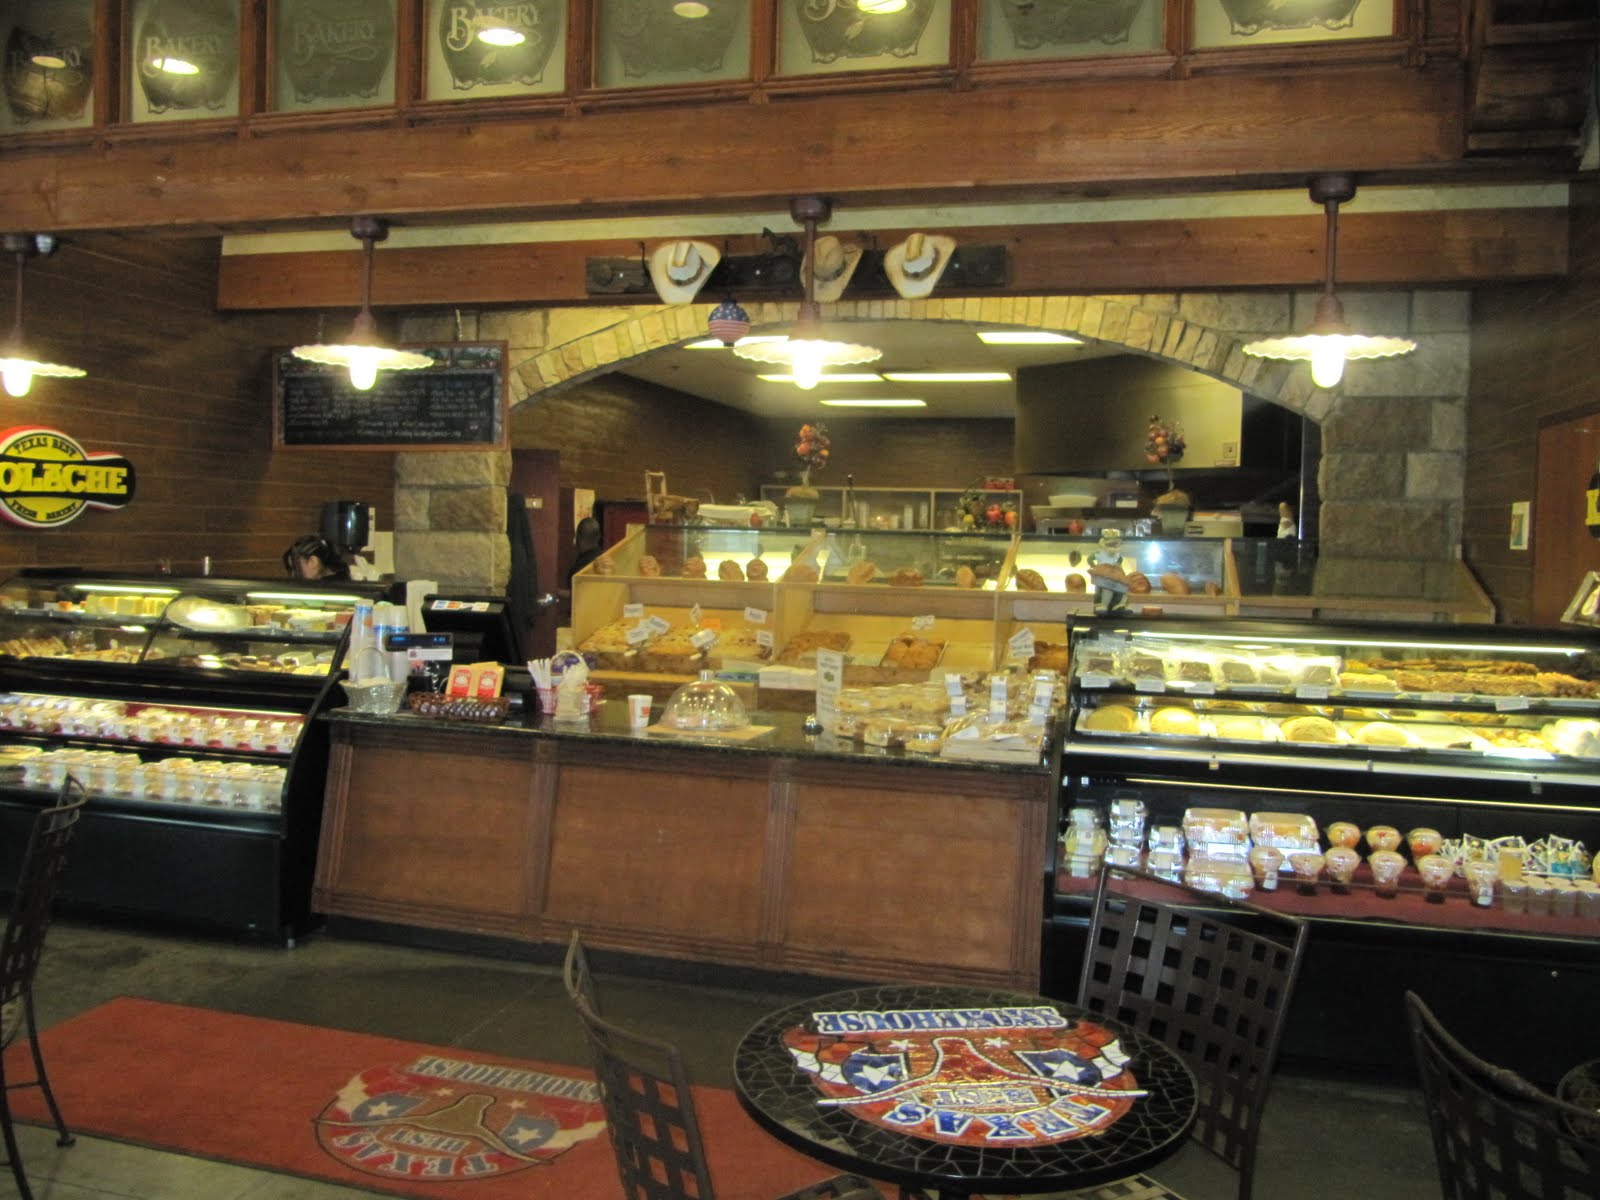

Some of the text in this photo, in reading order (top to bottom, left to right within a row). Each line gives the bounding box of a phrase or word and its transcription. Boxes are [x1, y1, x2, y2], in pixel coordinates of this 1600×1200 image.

[13, 437, 79, 457] TEXAS BEST
[0, 461, 128, 494] OLACHE
[931, 1087, 1039, 1108] BEST
[881, 1095, 1112, 1141] TEXAS
[331, 1130, 499, 1177] TEXAS
